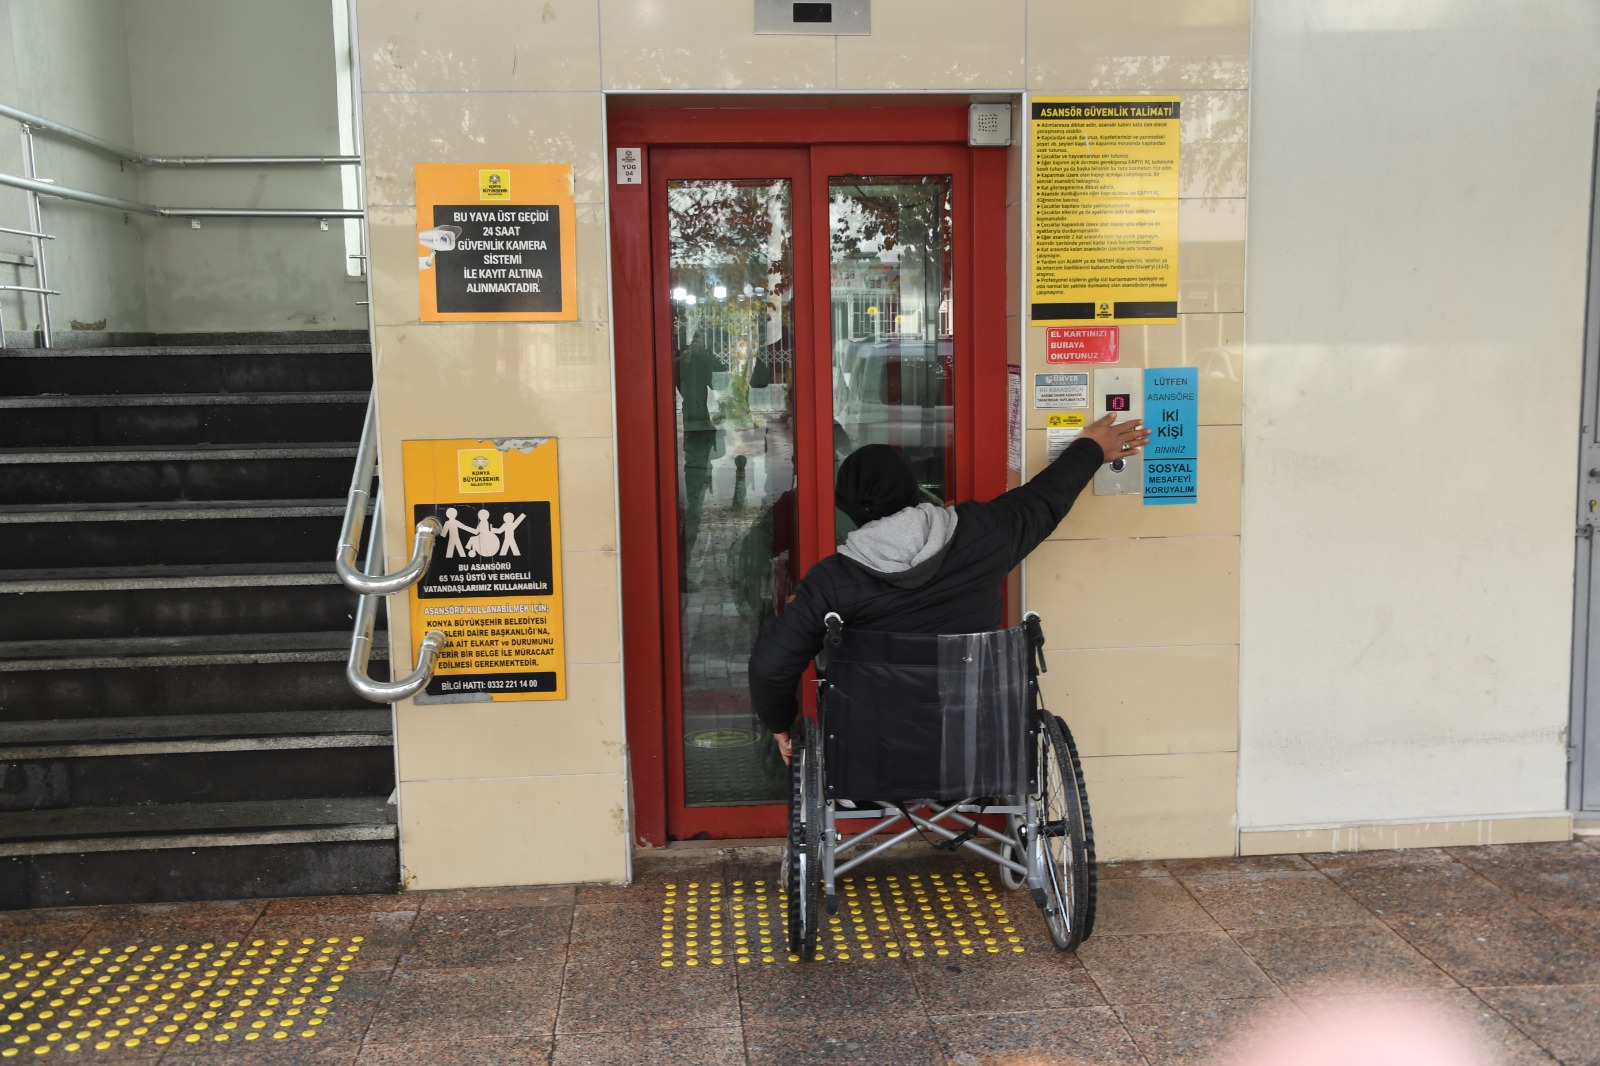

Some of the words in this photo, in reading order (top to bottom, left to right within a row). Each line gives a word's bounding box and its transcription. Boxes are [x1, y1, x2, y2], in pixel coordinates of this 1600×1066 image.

[1041, 106, 1082, 116] ASANSÖR
[1084, 106, 1128, 116] GÜVENLİK
[1131, 105, 1172, 116] TALİMATI
[454, 212, 467, 222] BU
[469, 212, 495, 222] YAYA
[498, 210, 516, 222] ÜST
[518, 210, 548, 224] GEÇİDİ
[483, 227, 493, 236] 24
[495, 227, 520, 236] SAAT
[458, 238, 504, 250] GÜVENLİK
[506, 241, 547, 250] KAMERA
[484, 253, 521, 264] SİSTEMİ
[464, 267, 477, 279] İLE
[479, 269, 506, 279] KAYIT
[508, 269, 542, 279] ALTINA
[467, 283, 540, 293] ALINMAKTADIR.
[1148, 392, 1194, 401] ASANSÖRE
[1112, 396, 1124, 410] 0
[1162, 409, 1178, 421] İKİ
[1158, 424, 1182, 438] KİŞİ
[1155, 445, 1185, 453] BİNİNİZ
[1148, 464, 1192, 473] SOSYAL
[471, 562, 511, 571] ASANSÖRÜ
[450, 574, 464, 583] YAŞ
[466, 573, 486, 581] ÜSTÜ
[500, 572, 531, 580] ENGELLİ
[424, 585, 492, 594] VATANDAŞLARIMIZ
[494, 582, 547, 591] KULLANABİLİR
[424, 605, 464, 615] ASANSÖRÜ
[467, 604, 529, 614] KULLANABİLMEK
[531, 604, 549, 615] İÇİN:
[454, 617, 502, 627] BÜYÜKŞEHİR
[505, 616, 547, 625] BELEDİYESİ
[467, 628, 489, 637] DAİRE
[491, 626, 550, 637] BAŞKANLIĞI'NA,
[456, 638, 468, 647] AİT
[471, 639, 499, 647] ELKART
[511, 637, 553, 646] DURUMUNU
[461, 649, 474, 657] BİR
[476, 649, 499, 657] BELGE
[501, 647, 512, 656] İLE
[515, 646, 554, 656] MÜRACAAT
[439, 658, 472, 668] EDİLMESİ
[474, 658, 539, 667] GEREKMEKTEDİR.
[442, 680, 461, 690] BİLGİ
[463, 681, 486, 690] HATTI:
[488, 681, 502, 689] 0332
